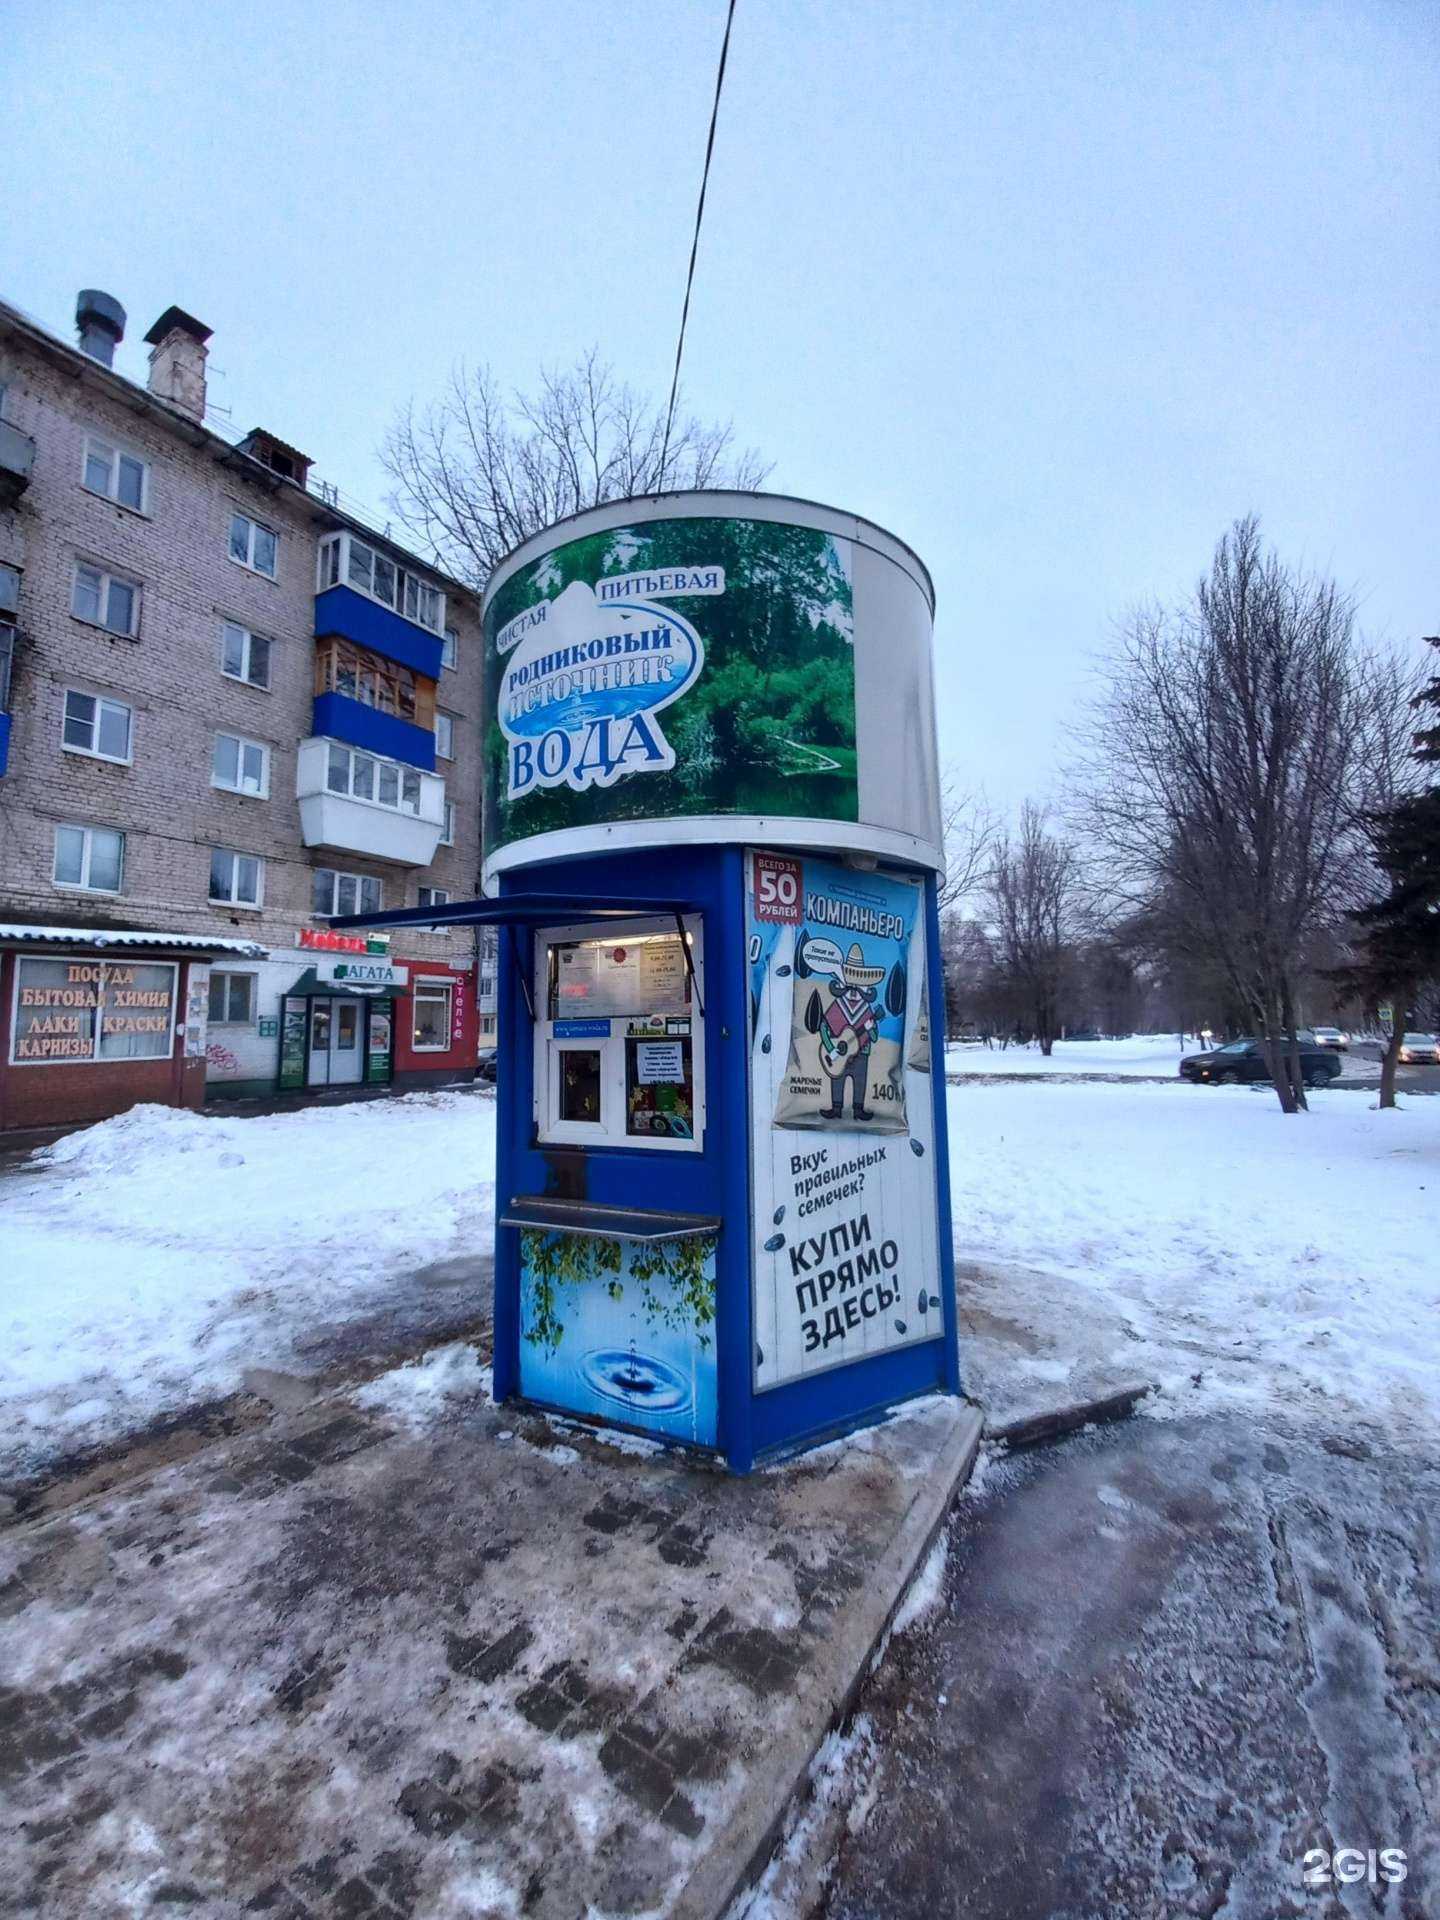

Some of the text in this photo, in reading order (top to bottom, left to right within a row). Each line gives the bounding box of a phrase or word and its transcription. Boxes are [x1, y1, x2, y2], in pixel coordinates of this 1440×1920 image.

[600, 572, 718, 600] ПИТЬЕВАЯ
[498, 605, 547, 648] ЧИСТАЯ
[509, 623, 673, 692] РОДНИКОВЫЙ
[509, 655, 674, 717] ИСТОЧНИК
[512, 713, 665, 790] ВОДА
[758, 859, 797, 872] ВСЕГО ЗА
[759, 870, 797, 905] 50
[759, 905, 798, 918] РУБЛЕЙ
[806, 893, 904, 940] КОМПАНЬЕРО
[68, 966, 134, 984] ПОСУДА
[350, 965, 394, 980] АГАТА
[22, 989, 169, 1008] БЫТОВАЯ ХИМИЯ
[28, 1015, 167, 1033] ЛАКИ КРАСКИ
[18, 1037, 93, 1056] КАРНИЗЫ
[790, 1149, 828, 1175] Вкус
[795, 1147, 887, 1197] правильных
[798, 1173, 865, 1217] семечек?
[789, 1213, 871, 1276] КУПИ
[796, 1240, 898, 1314] ПРЯМО
[801, 1274, 901, 1352] ЗДЕСЬ!
